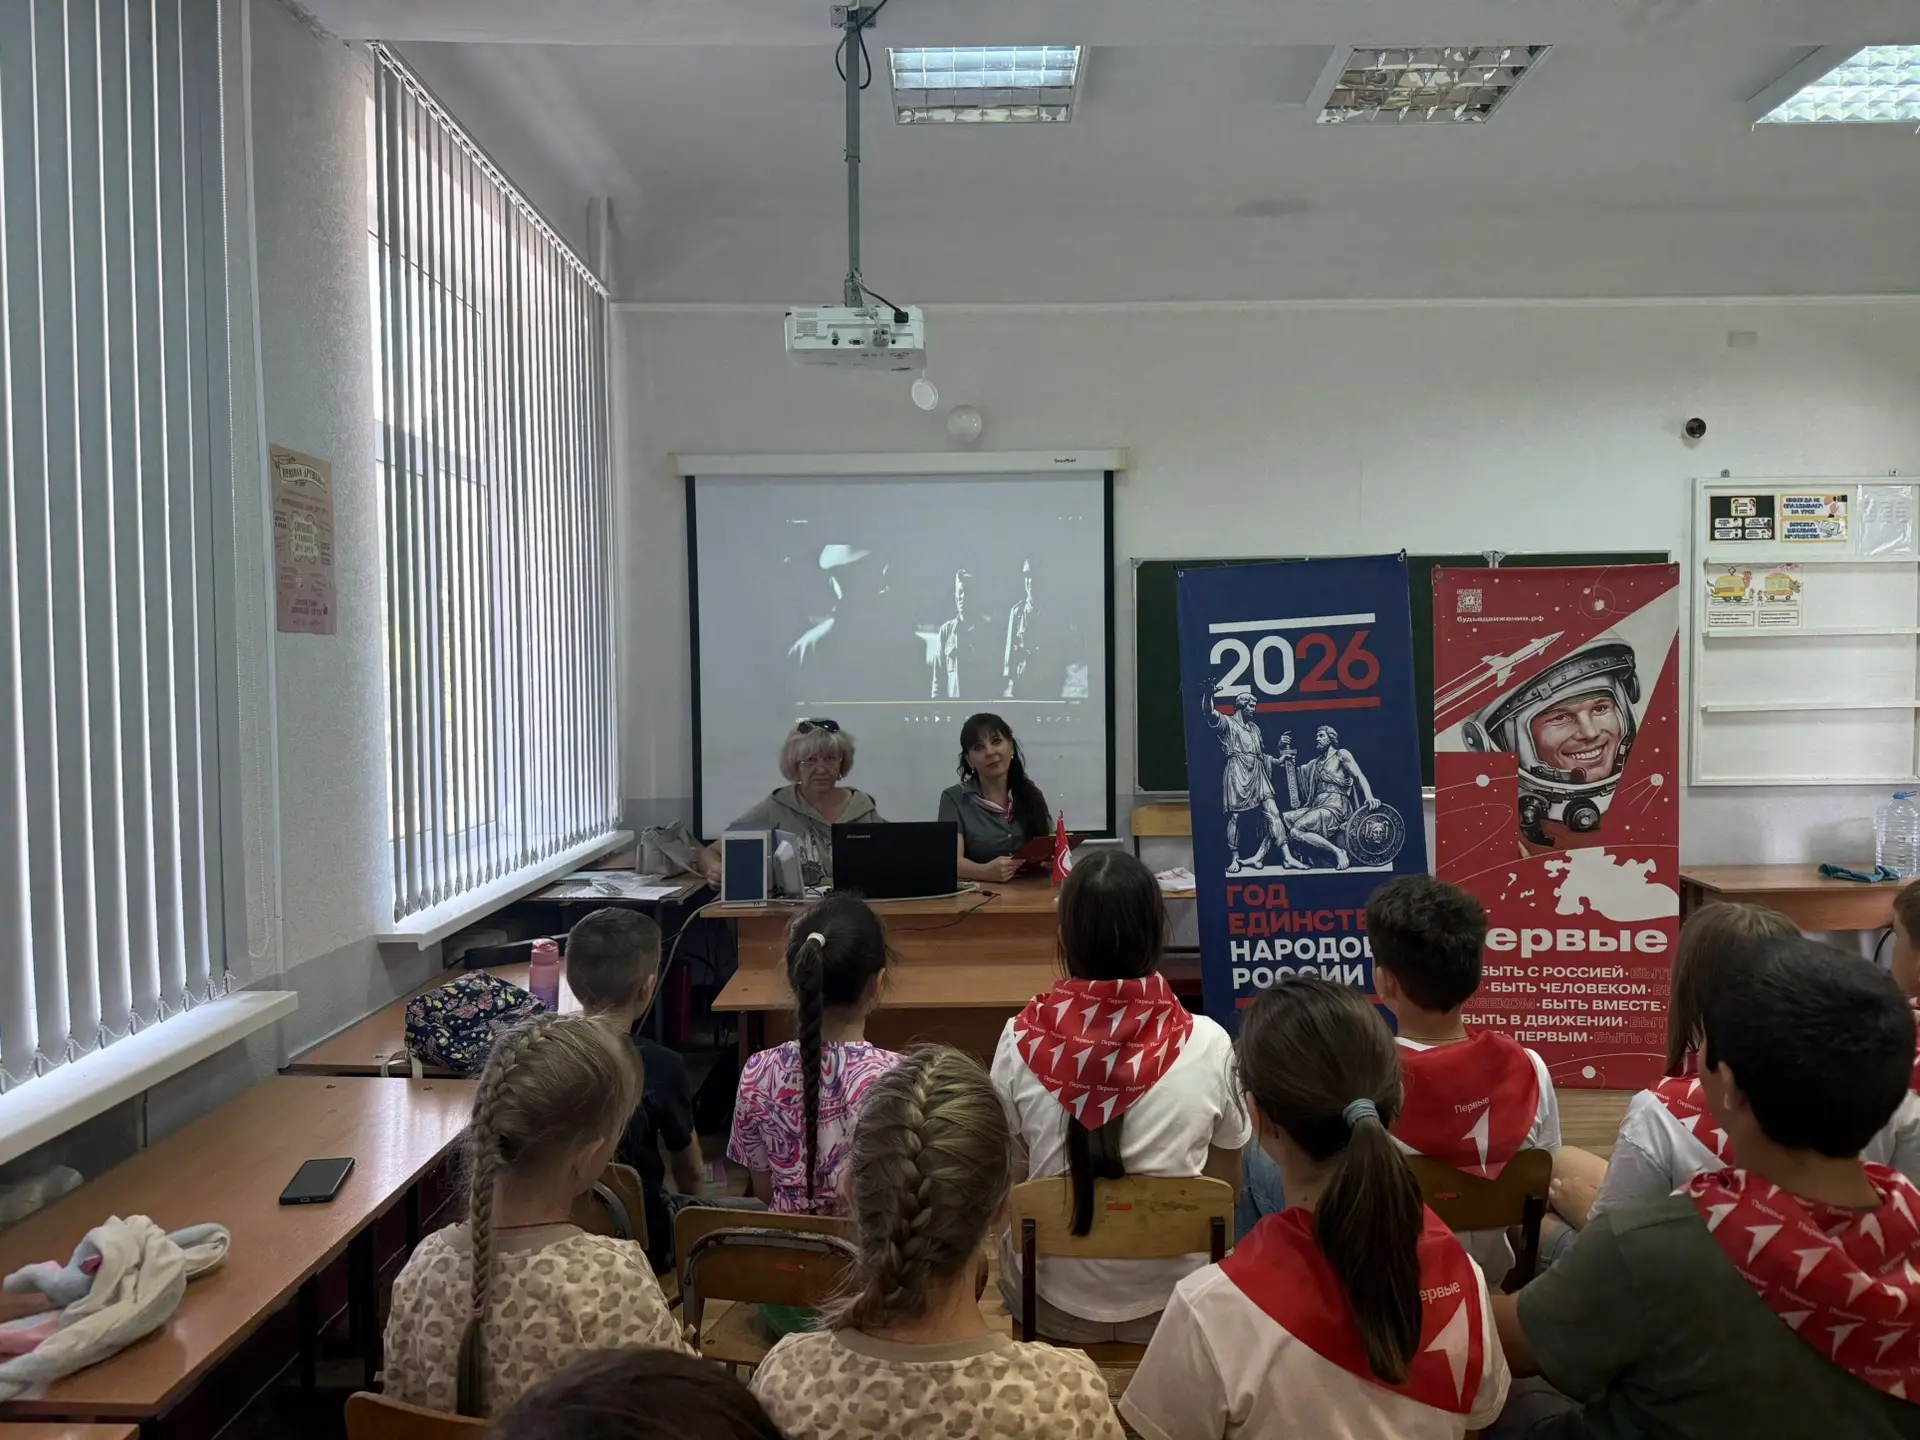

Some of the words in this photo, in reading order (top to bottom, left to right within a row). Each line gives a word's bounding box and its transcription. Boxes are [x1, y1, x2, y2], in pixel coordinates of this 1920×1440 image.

[1210, 631, 1381, 697] 2026
[1226, 883, 1290, 909] ГОД
[1485, 927, 1668, 958] ервые
[1481, 965, 1525, 977] БЫТЬ
[1527, 966, 1540, 977] С
[1543, 965, 1624, 979] РОССИЕЙ
[1490, 982, 1537, 993] БЫТЬ
[1540, 982, 1646, 995] ЧЕЛОВЕКОМ
[1542, 998, 1589, 1010] БЫТЬ
[1592, 999, 1661, 1012] ВМЕСТЕ
[1461, 1014, 1507, 1025] БЫТЬ
[1510, 1014, 1521, 1025] В
[1524, 1015, 1623, 1027] ДВИЖЕНИИ
[1514, 1030, 1588, 1043] ПЕРВЫМ
[1454, 1096, 1490, 1114] Первые
[1419, 1280, 1461, 1304] ервые
